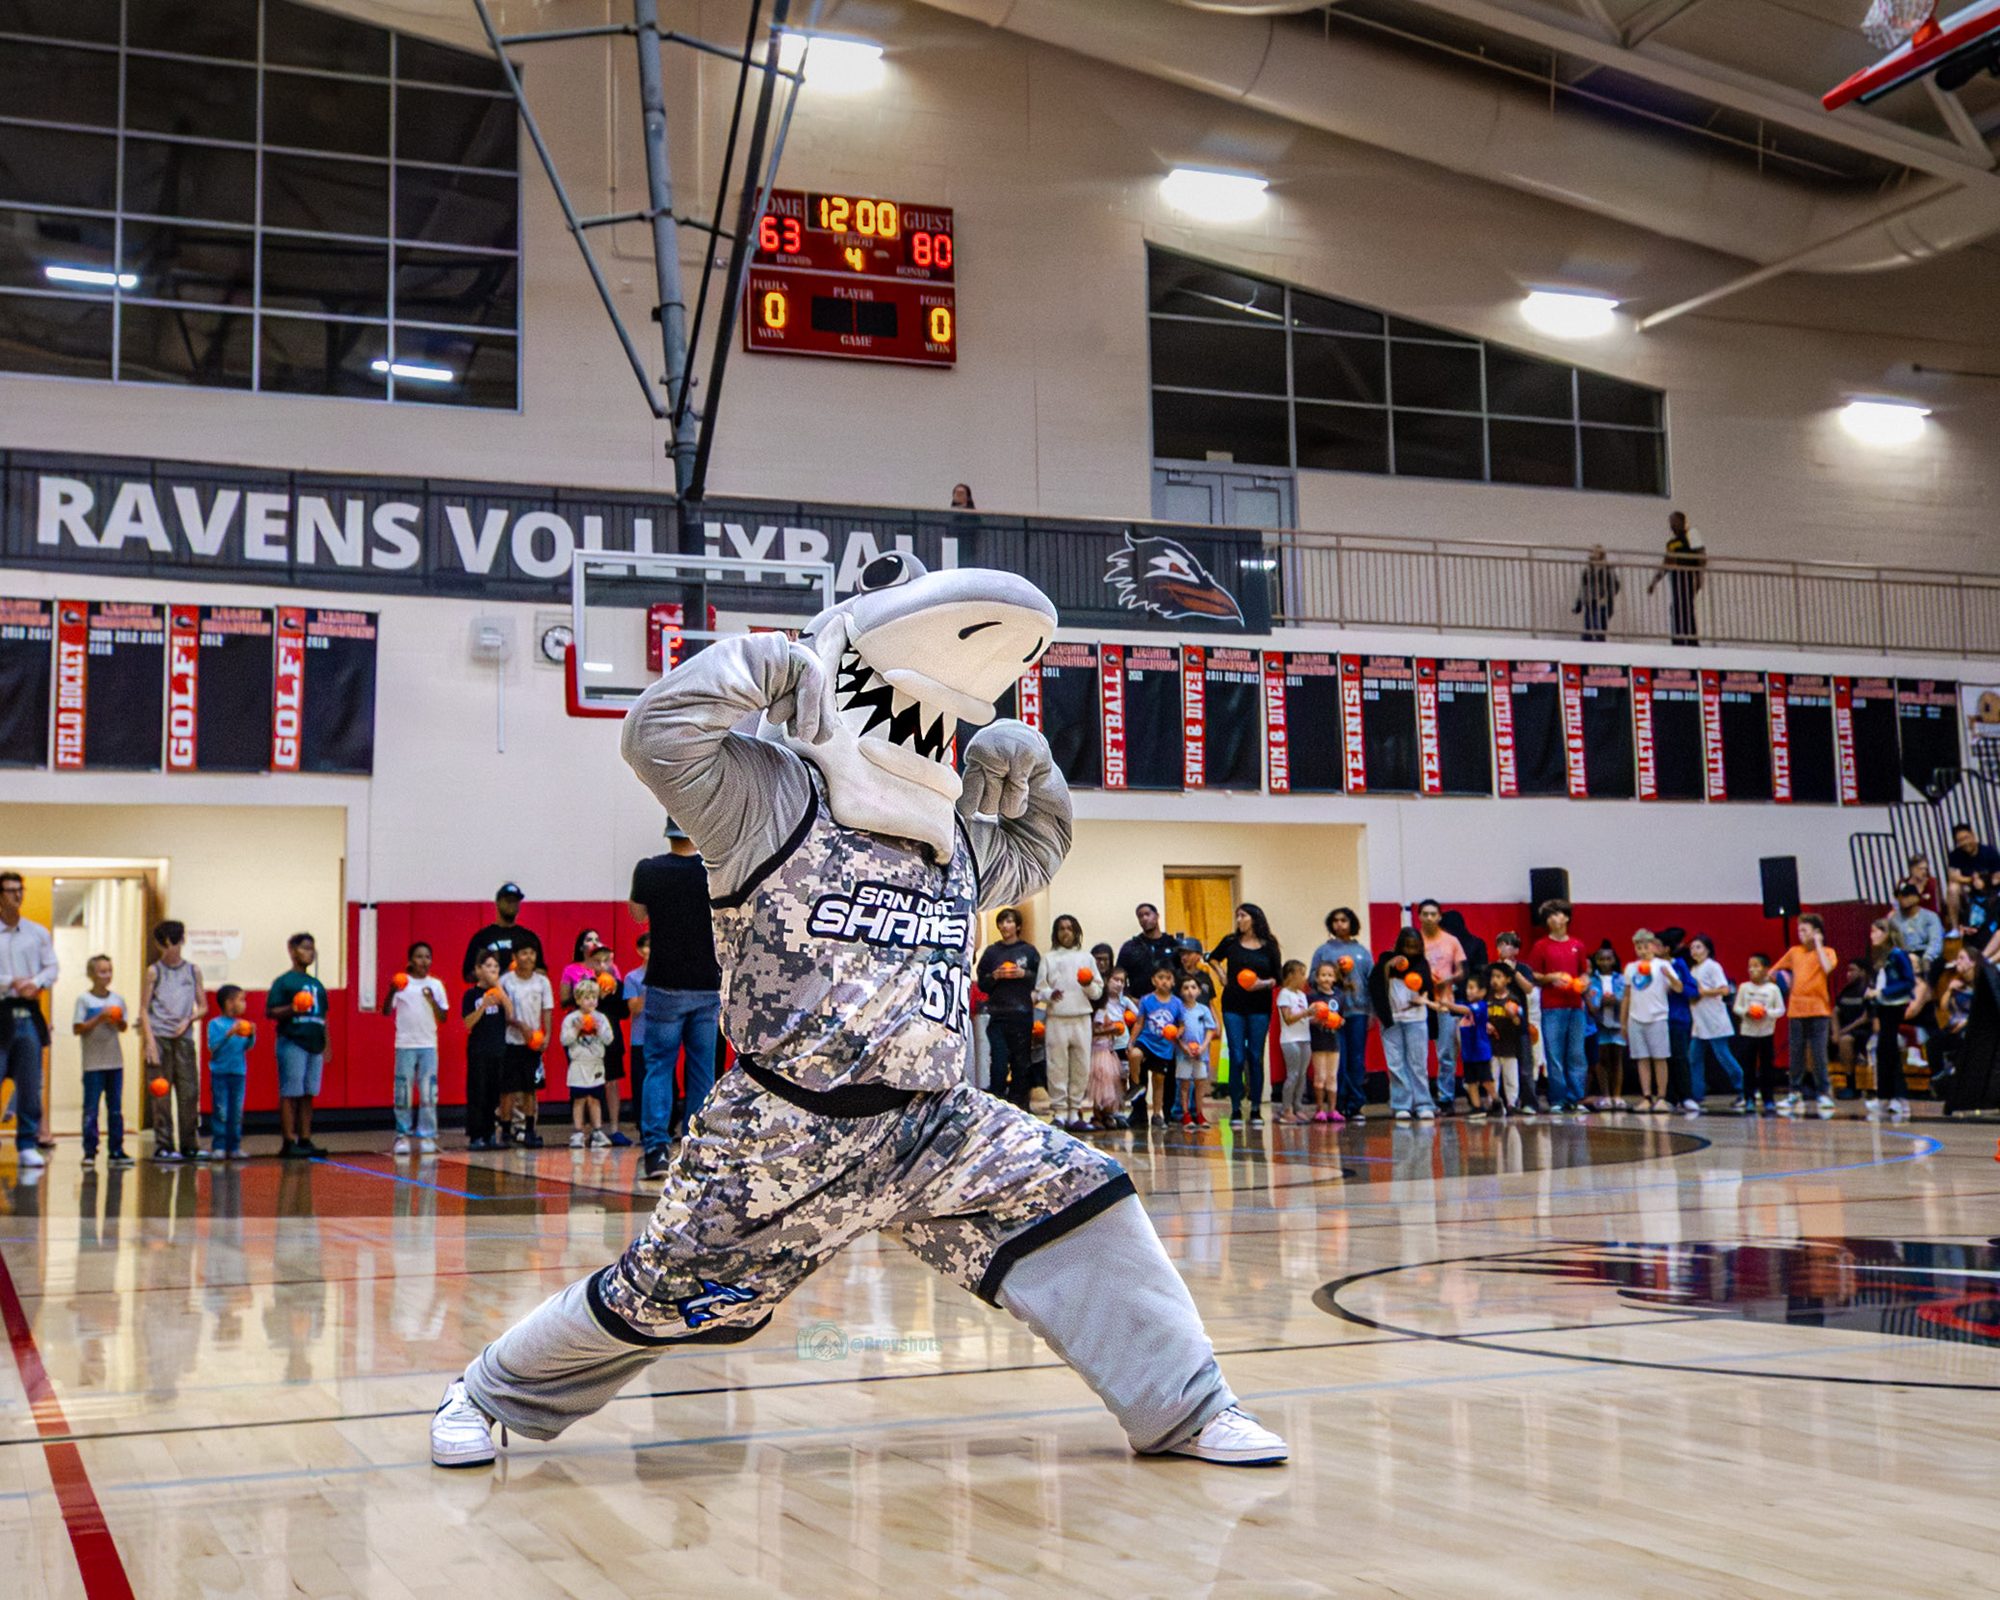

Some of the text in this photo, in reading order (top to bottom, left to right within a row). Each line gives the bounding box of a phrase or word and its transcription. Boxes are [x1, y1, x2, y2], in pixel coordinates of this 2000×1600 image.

[760, 216, 800, 254] 63
[904, 211, 953, 232] GUEST
[844, 246, 863, 271] 4
[912, 232, 953, 268] 80
[764, 291, 786, 328] 0
[833, 286, 874, 301] PLAYER
[840, 334, 873, 347] GAME
[930, 307, 951, 342] 0
[37, 475, 422, 571] RAVENS
[1042, 667, 1060, 677] 2011
[57, 641, 84, 764] FIELD HOCKEY
[170, 647, 195, 766] GOLF
[274, 647, 301, 766] GOLF
[1186, 680, 1203, 718] DIVE
[1267, 686, 1285, 725] DIVE
[1494, 693, 1514, 732] FIELD
[1104, 669, 1125, 785] SOFTBALL
[1344, 688, 1365, 789] TENNIS
[1420, 693, 1440, 792] TENNIS
[1635, 698, 1656, 796] VOLLEYBALL
[1186, 741, 1203, 785] SWIM
[1270, 746, 1288, 789] SWIM
[1703, 702, 1726, 798] VOLLEYBALL
[1771, 703, 1791, 798] WATER POLO
[1839, 708, 1858, 800] WRESTLING
[1499, 750, 1517, 793] TRACK
[1568, 752, 1586, 794] TRACK
[856, 886, 913, 911] SAN
